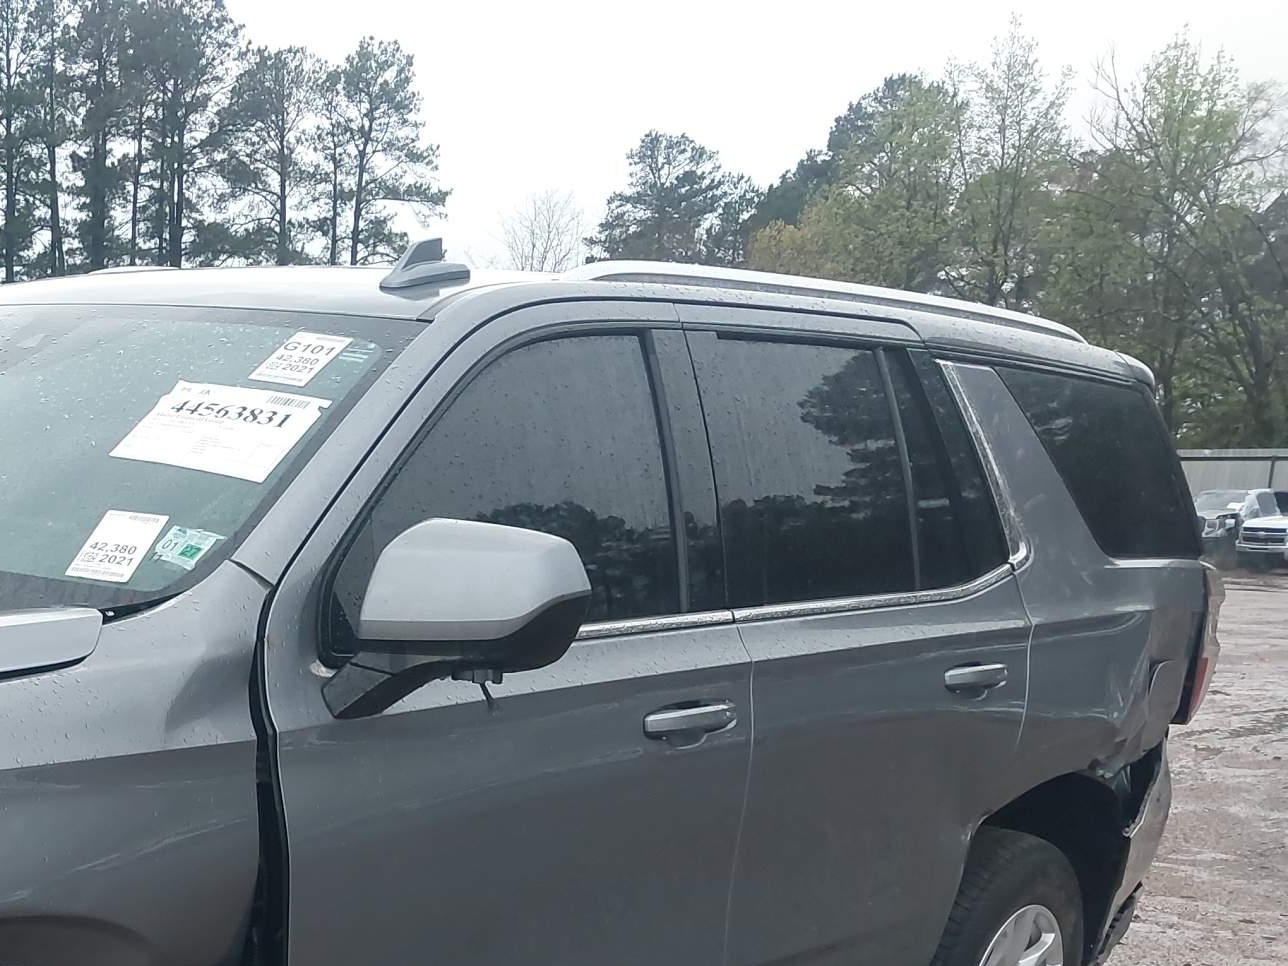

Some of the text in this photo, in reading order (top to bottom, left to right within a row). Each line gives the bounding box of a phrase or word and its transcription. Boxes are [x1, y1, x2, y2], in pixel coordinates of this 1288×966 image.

[283, 341, 336, 356] G101
[281, 363, 314, 374] 2021
[171, 399, 292, 428] 44563831
[89, 541, 137, 555] 42,380
[98, 554, 135, 567] 2021
